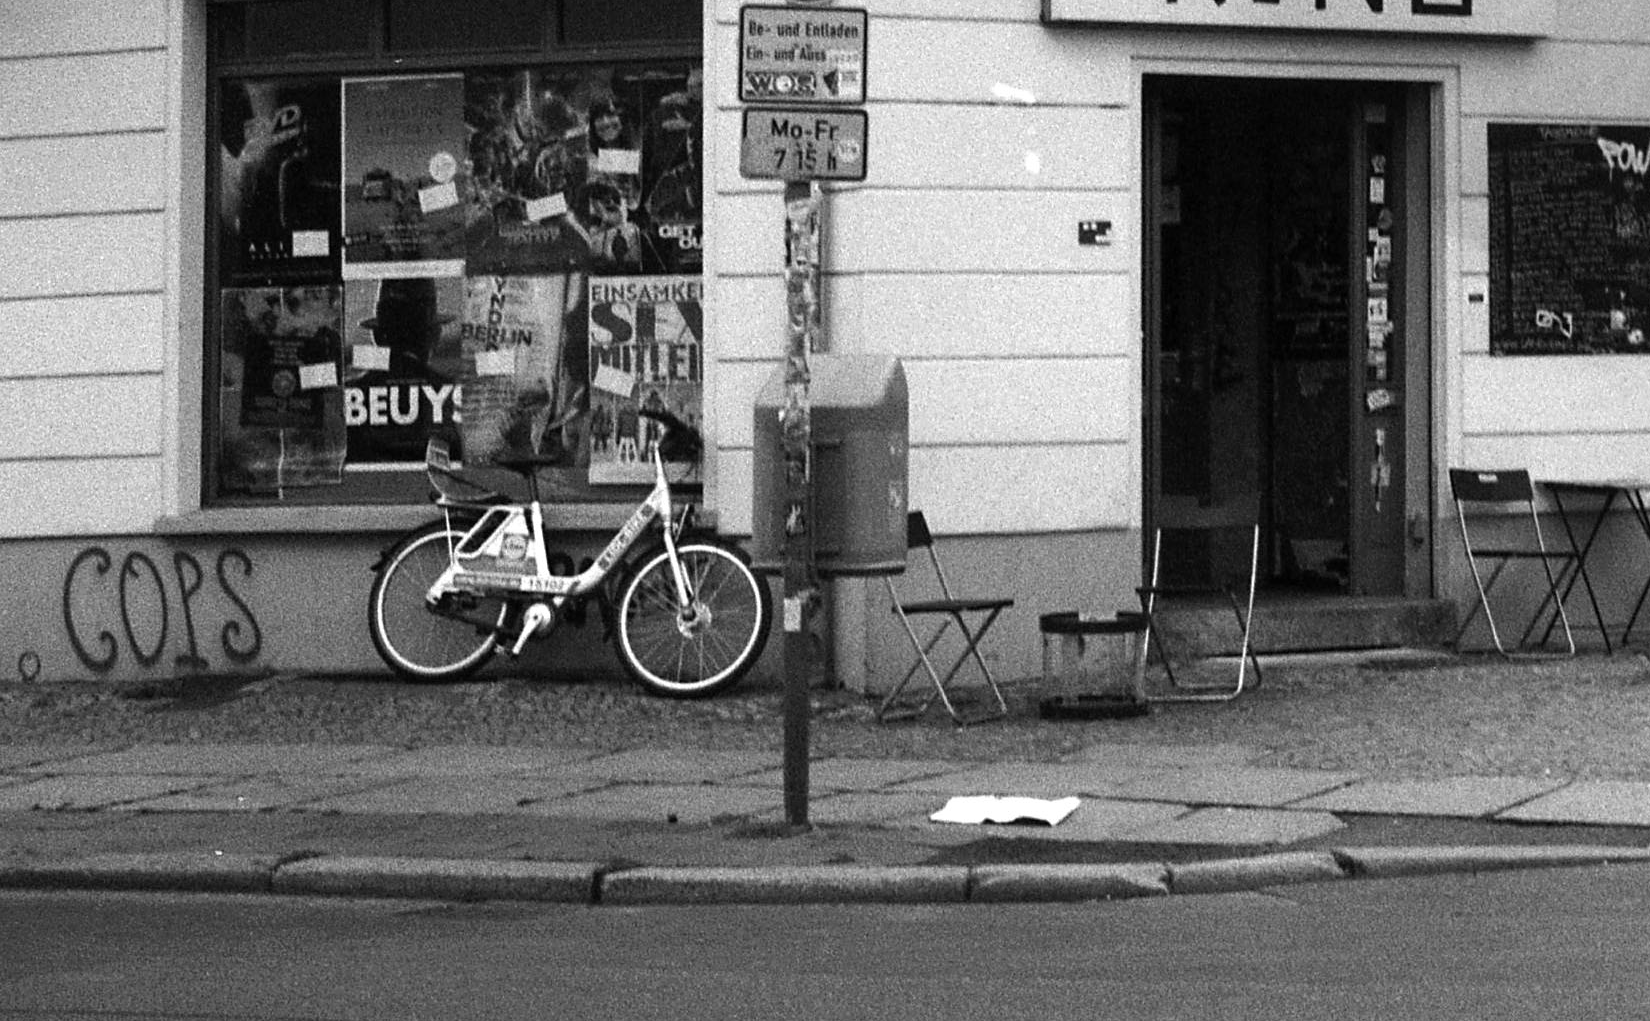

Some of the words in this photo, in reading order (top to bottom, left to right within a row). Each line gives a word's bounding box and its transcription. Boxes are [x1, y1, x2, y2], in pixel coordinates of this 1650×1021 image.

[776, 22, 801, 38] und
[805, 22, 859, 39] Entladen
[773, 46, 796, 63] und
[770, 119, 840, 141] Mo-Fr
[826, 151, 837, 171] h
[461, 322, 533, 347] BERLIN
[63, 546, 263, 674] COPS
